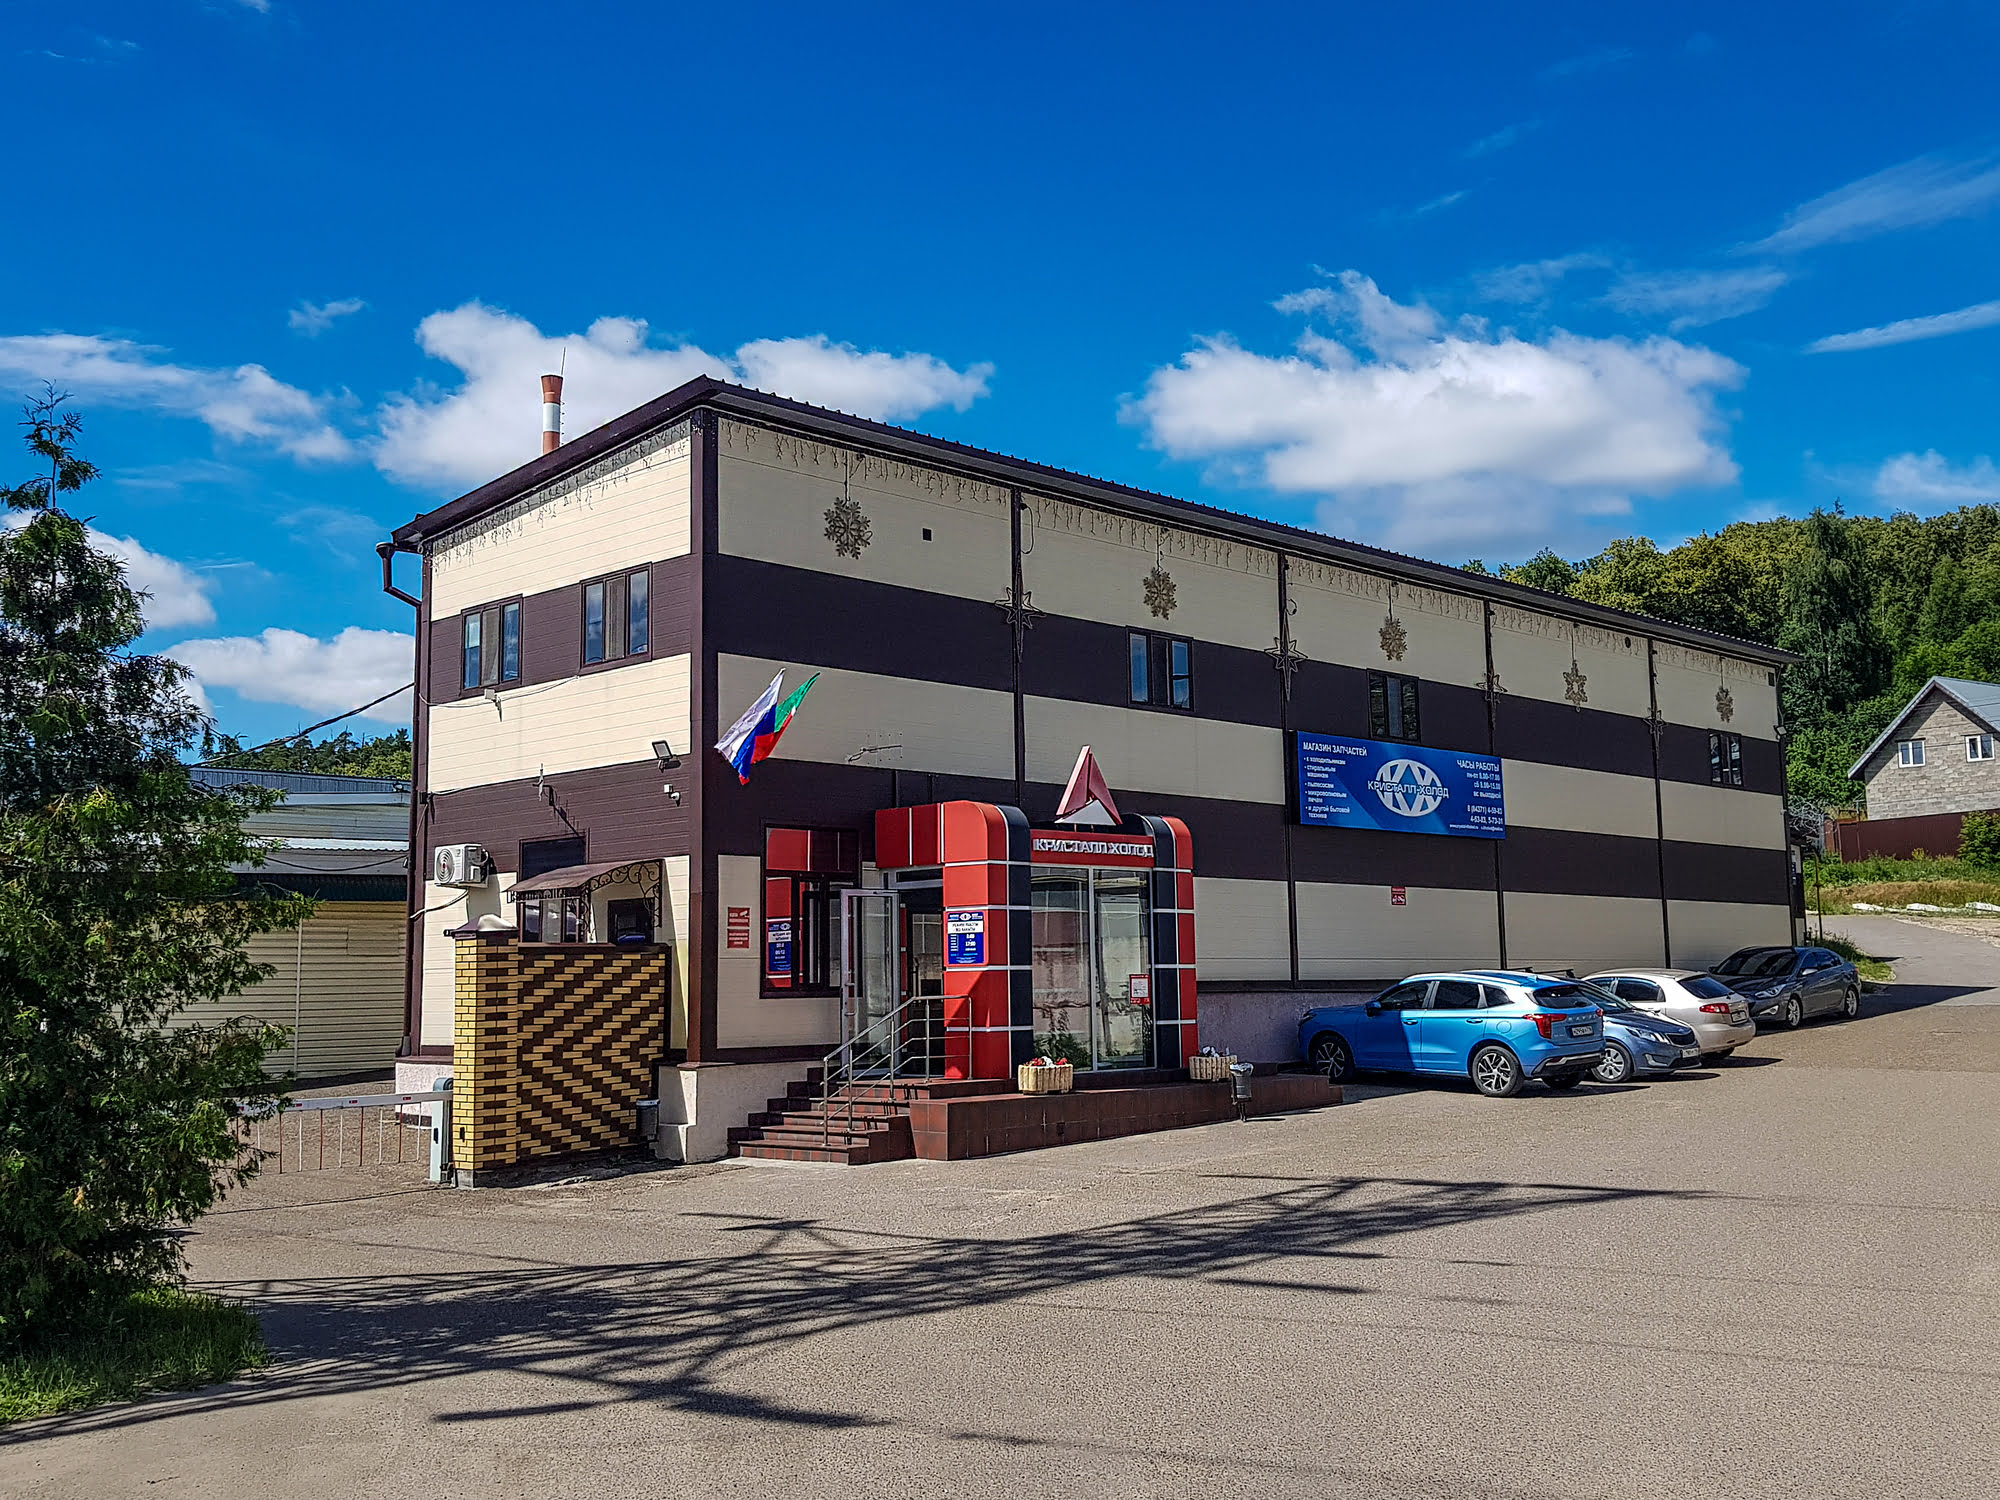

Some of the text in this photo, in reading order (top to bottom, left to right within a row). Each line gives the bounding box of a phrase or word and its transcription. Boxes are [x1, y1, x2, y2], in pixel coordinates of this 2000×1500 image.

[1303, 741, 1368, 756] МАГАЗИН ЗАПЧАСТЕЙ
[1457, 759, 1500, 772] ЧАСЫ РАБОТЫ
[1367, 780, 1450, 799] КРИСТАЛЛ-ХОЛОД
[1033, 838, 1154, 858] КРИСТАЛЛ ХОЛОД
